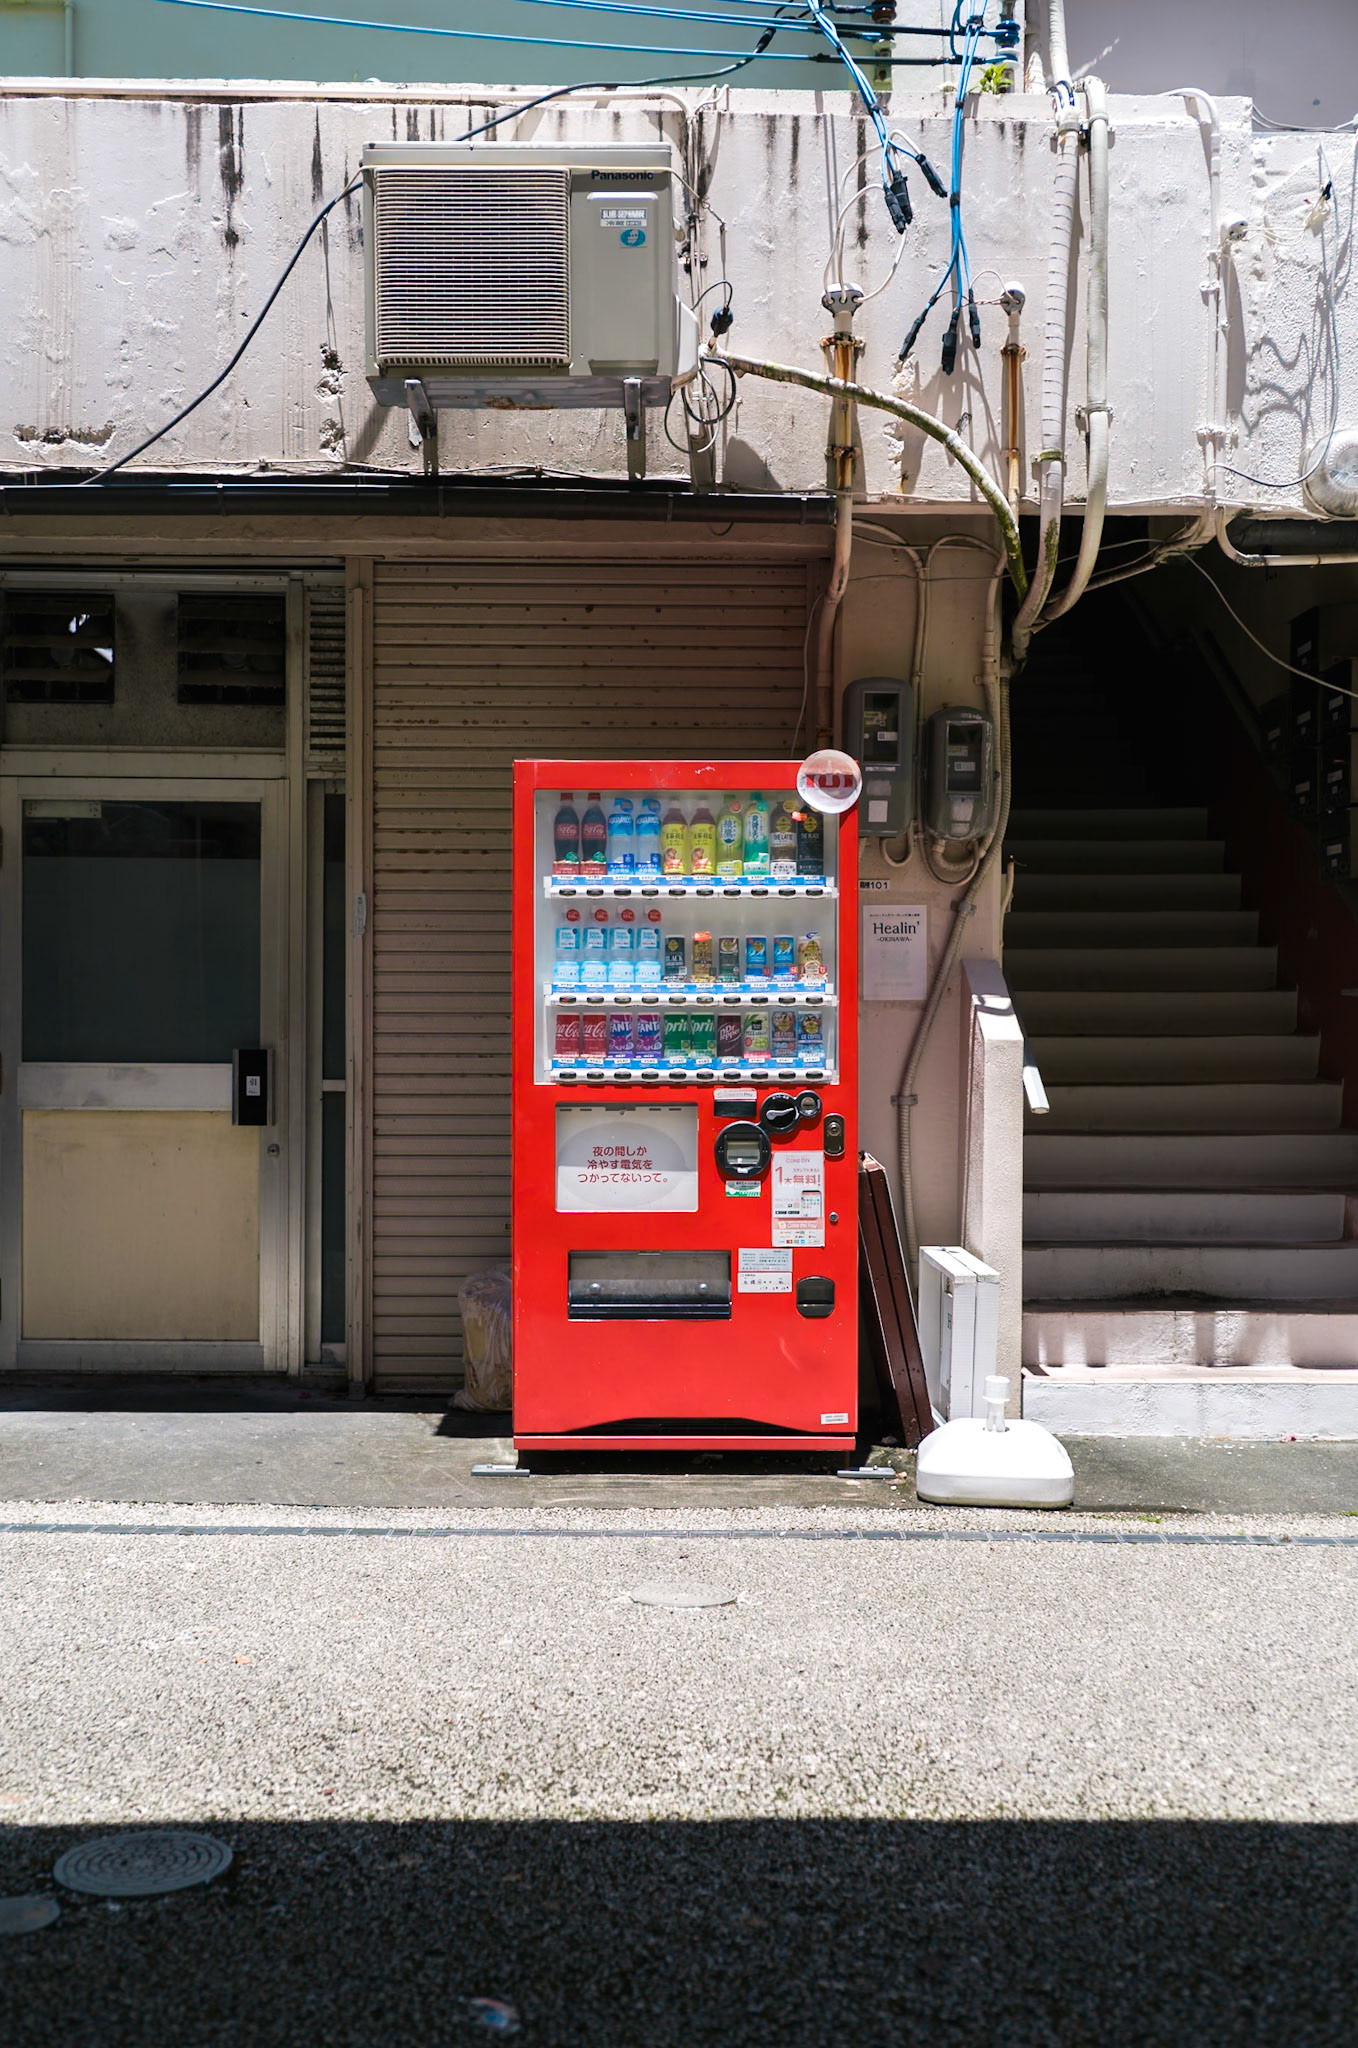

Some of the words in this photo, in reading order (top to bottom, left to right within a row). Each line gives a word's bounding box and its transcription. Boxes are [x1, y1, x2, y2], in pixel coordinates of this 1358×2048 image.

[591, 169, 654, 180] Panasonic
[873, 920, 920, 934] Healin'
[592, 1146, 647, 1157] 夜の間しか
[587, 1159, 653, 1170] 冷やす電気を
[577, 1173, 669, 1183] つかってないって。
